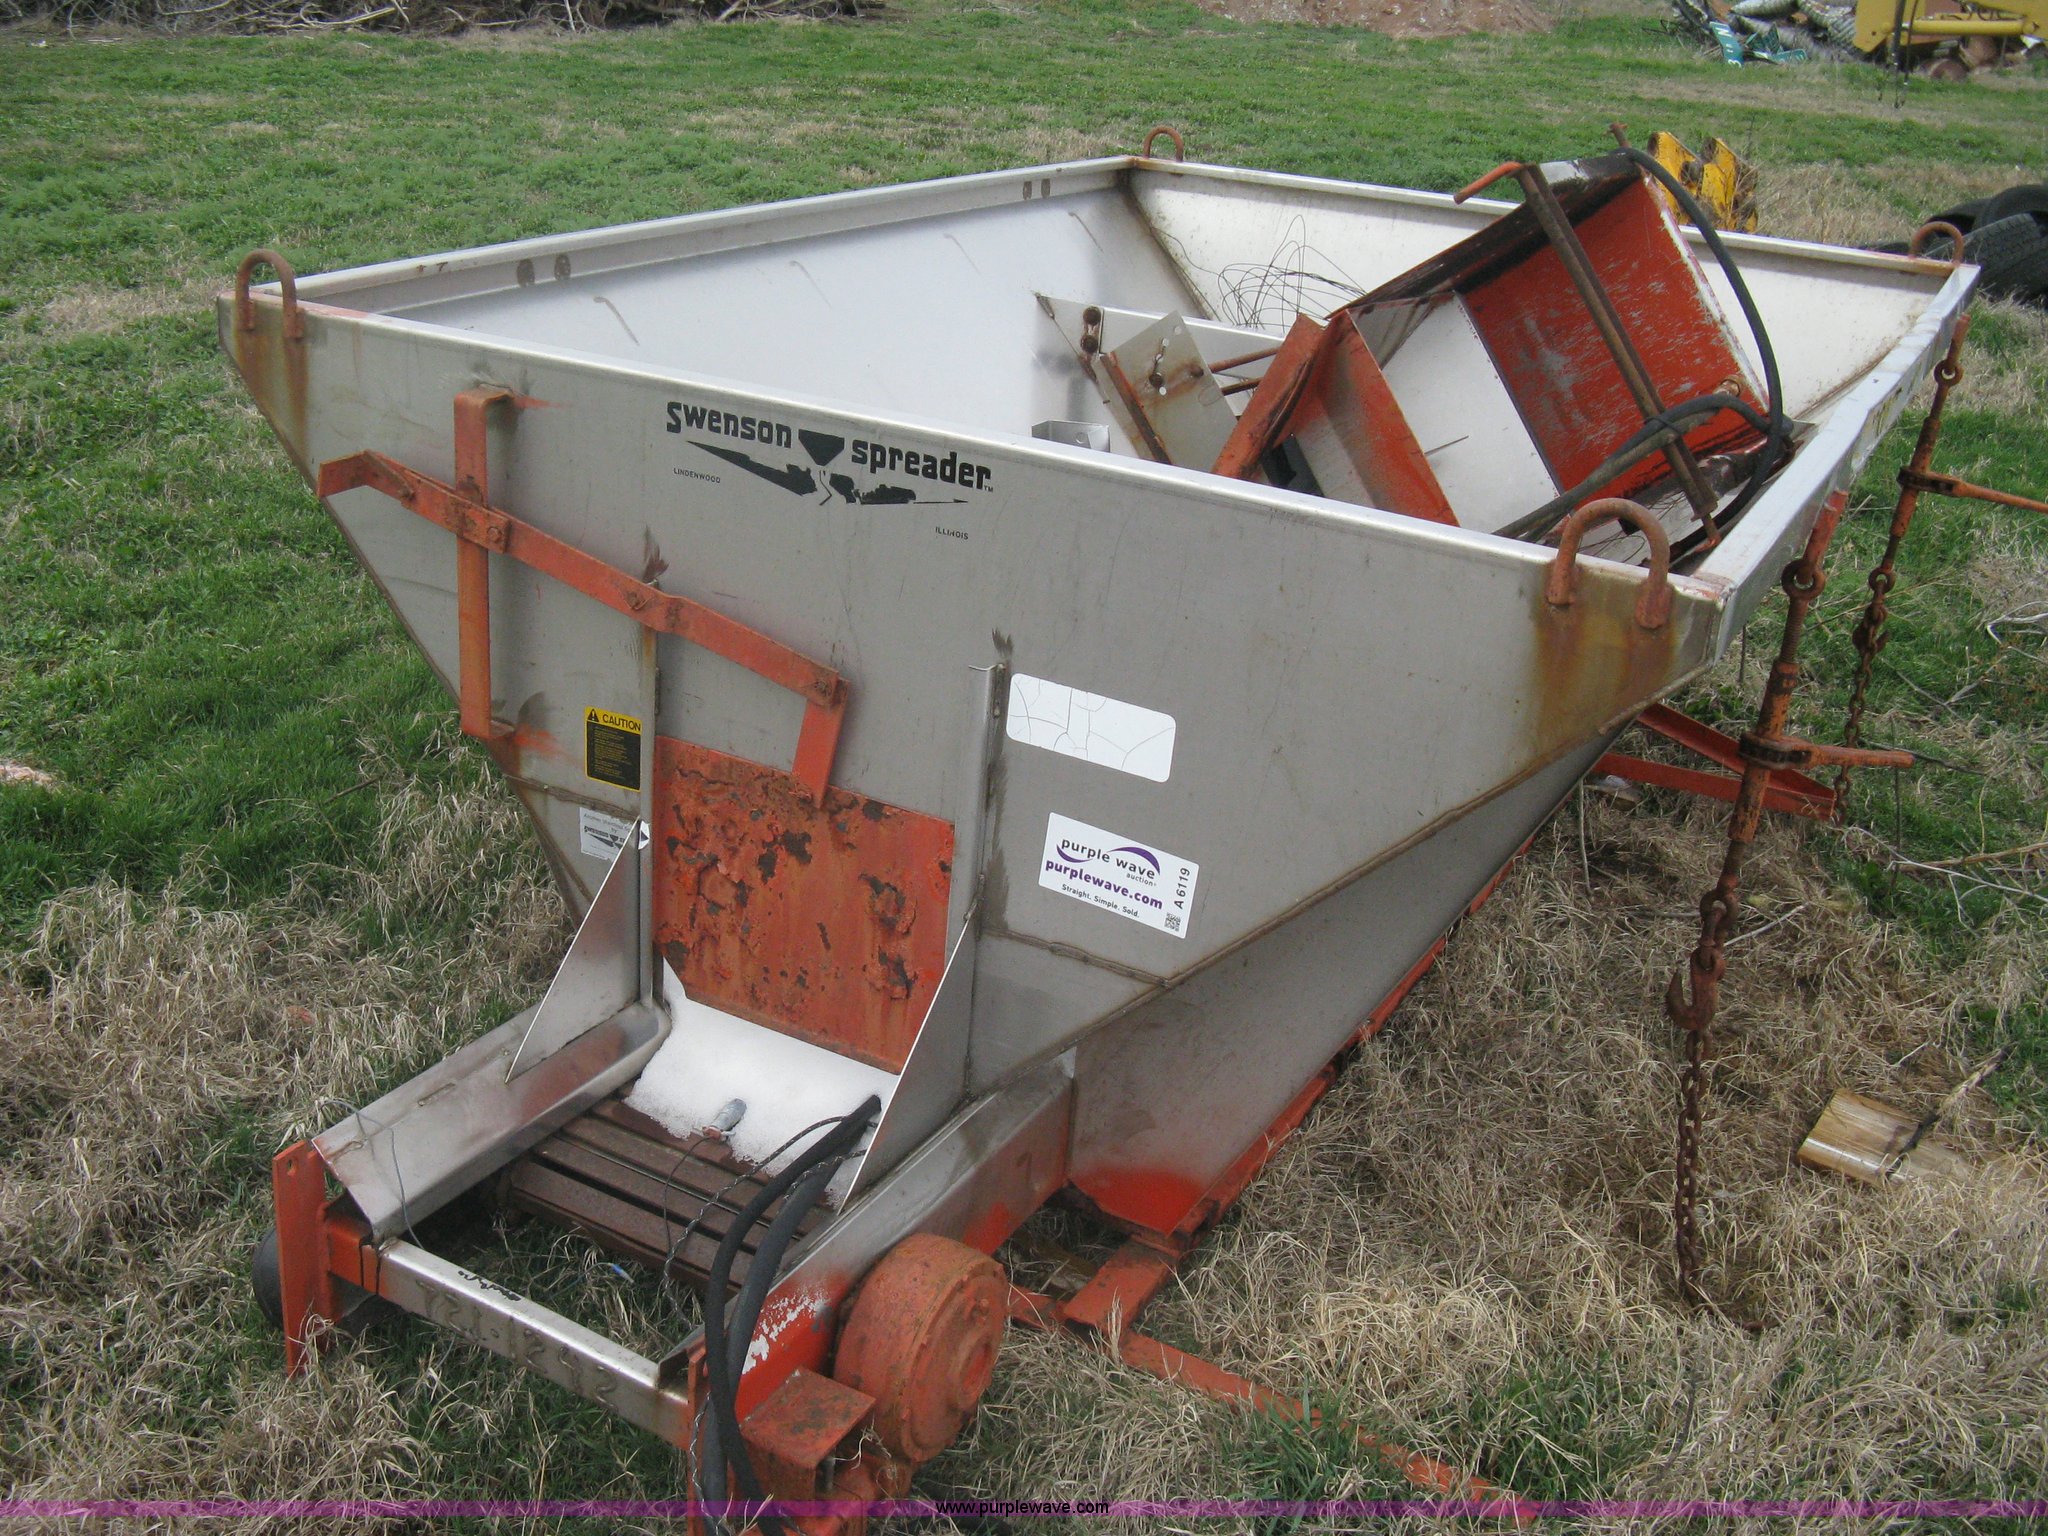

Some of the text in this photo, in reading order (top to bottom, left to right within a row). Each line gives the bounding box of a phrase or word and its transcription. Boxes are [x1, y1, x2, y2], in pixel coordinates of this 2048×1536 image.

[666, 401, 792, 449] Swenson
[852, 439, 992, 490] spreader
[673, 467, 721, 484] LINDENWOOD
[935, 526, 969, 540] ILLINOIS
[602, 713, 641, 732] CAUTION
[1061, 838, 1155, 880] purple wave
[1045, 860, 1163, 910] purplewave.com
[1062, 883, 1140, 918] Straight. Simple. Sold.
